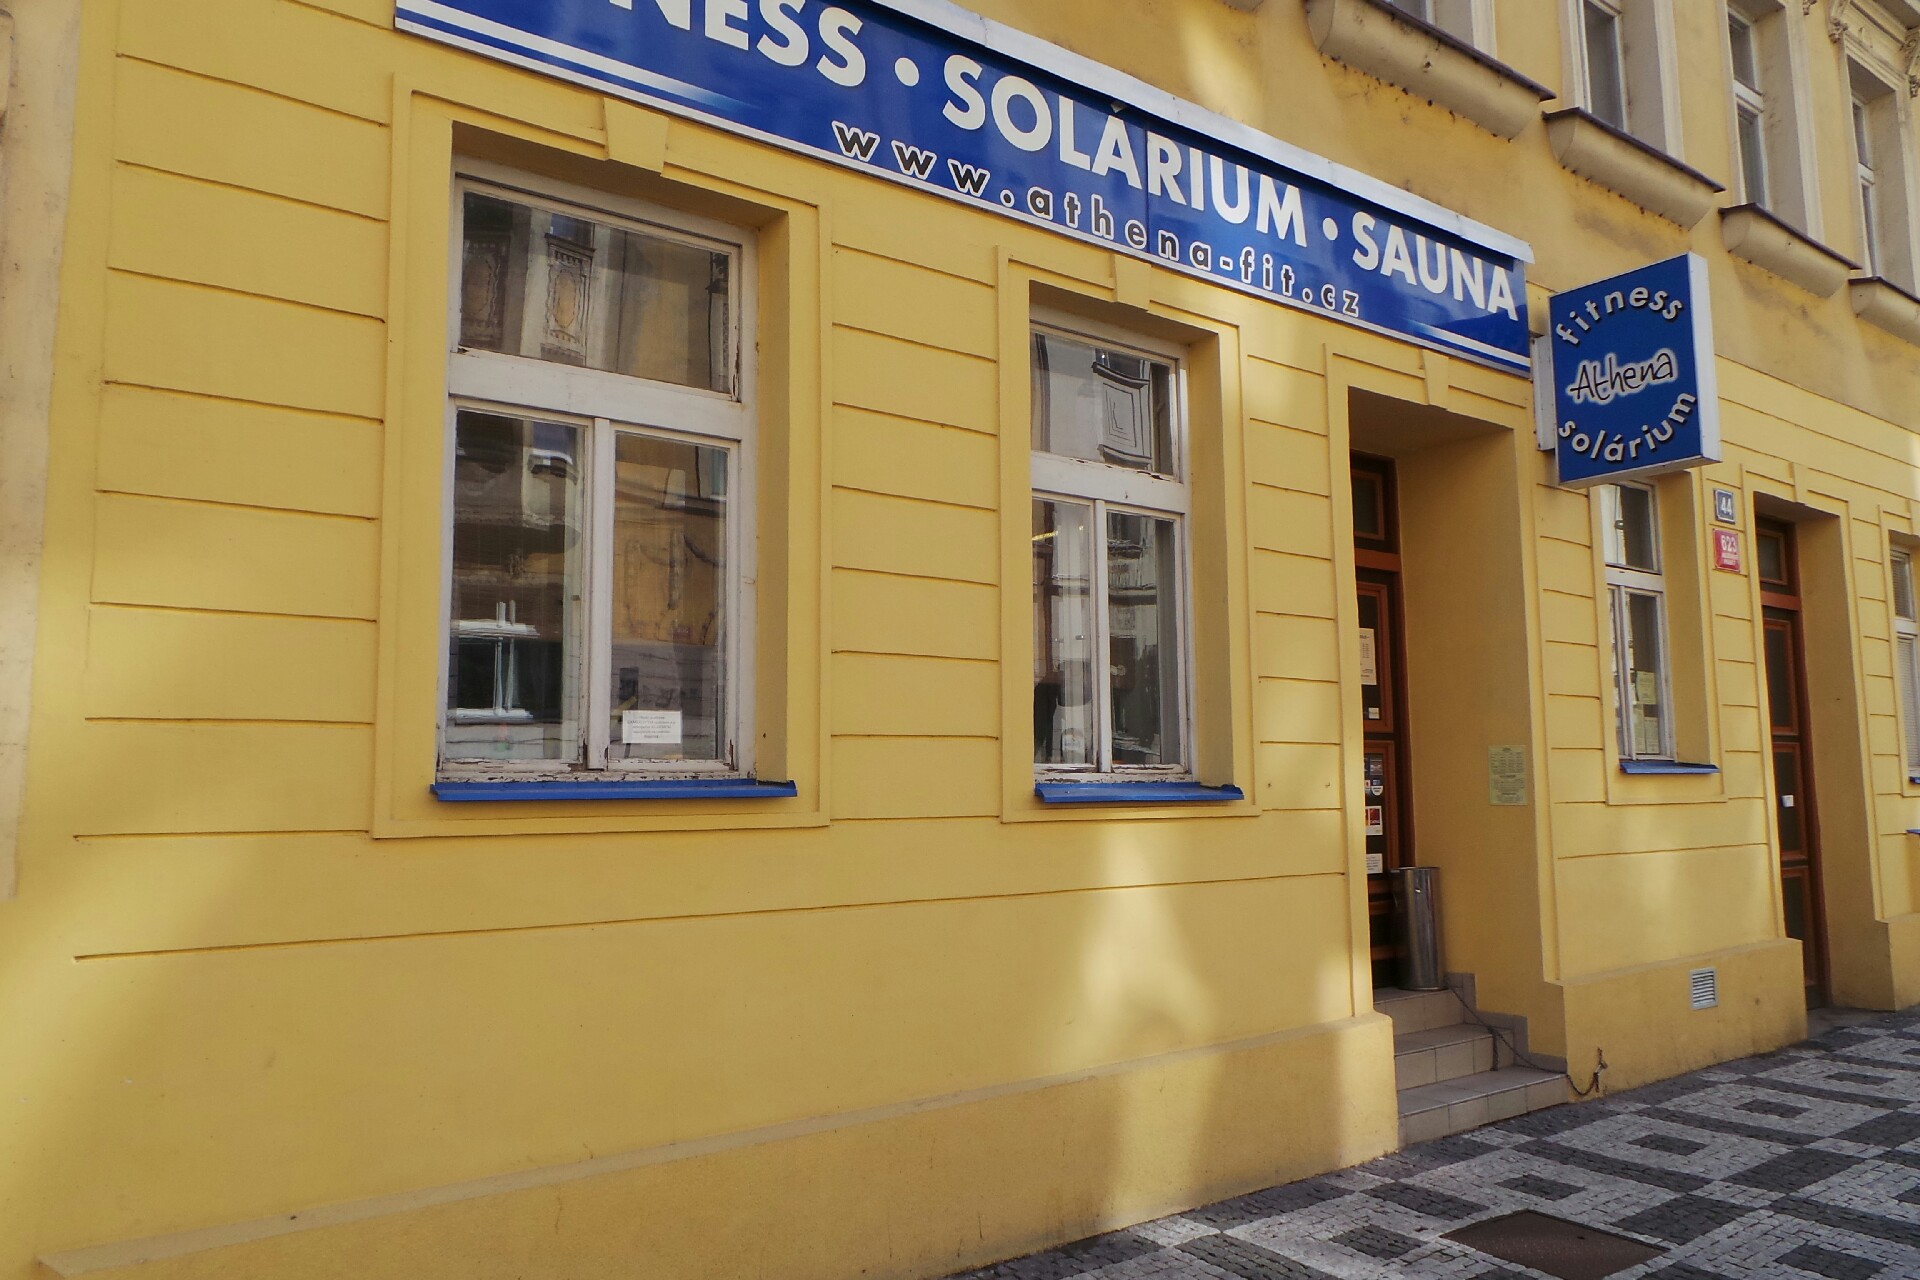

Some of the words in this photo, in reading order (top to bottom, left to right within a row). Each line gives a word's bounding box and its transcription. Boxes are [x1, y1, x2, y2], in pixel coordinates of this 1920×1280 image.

[609, 0, 867, 87] ESS
[942, 54, 1308, 248] SOLÁRIUM
[1352, 211, 1519, 322] SAUNA
[831, 120, 1359, 318] www.athena-fit.cz
[1555, 286, 1684, 346] fitness
[1568, 350, 1676, 402] Athena
[1557, 391, 1697, 462] solárium
[1720, 496, 1733, 516] 44
[1720, 534, 1738, 553] 623
